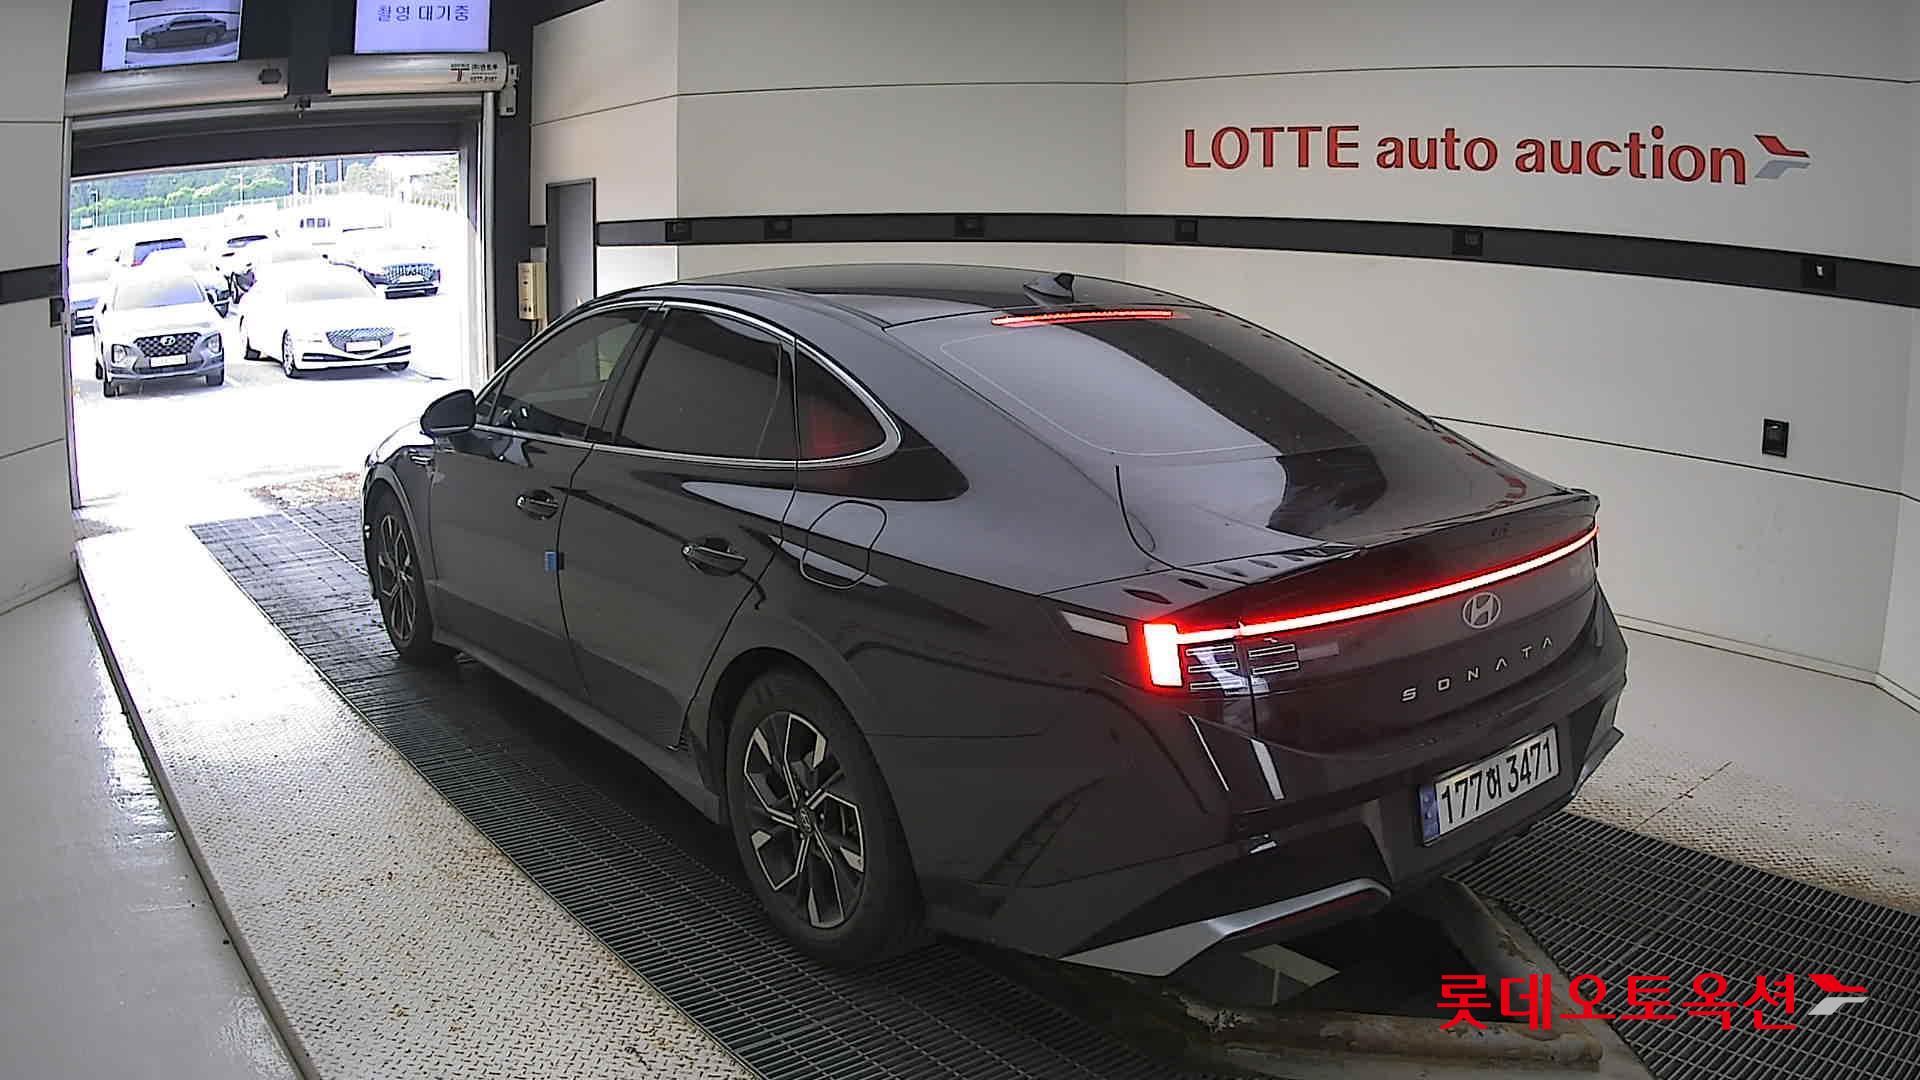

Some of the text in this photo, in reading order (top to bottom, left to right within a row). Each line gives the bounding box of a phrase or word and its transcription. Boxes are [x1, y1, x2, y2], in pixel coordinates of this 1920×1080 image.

[418, 4, 469, 22] 대기중
[1185, 124, 1747, 185] LOTTE auto auction
[1401, 636, 1553, 702] SONATA
[1506, 735, 1552, 793] 3471
